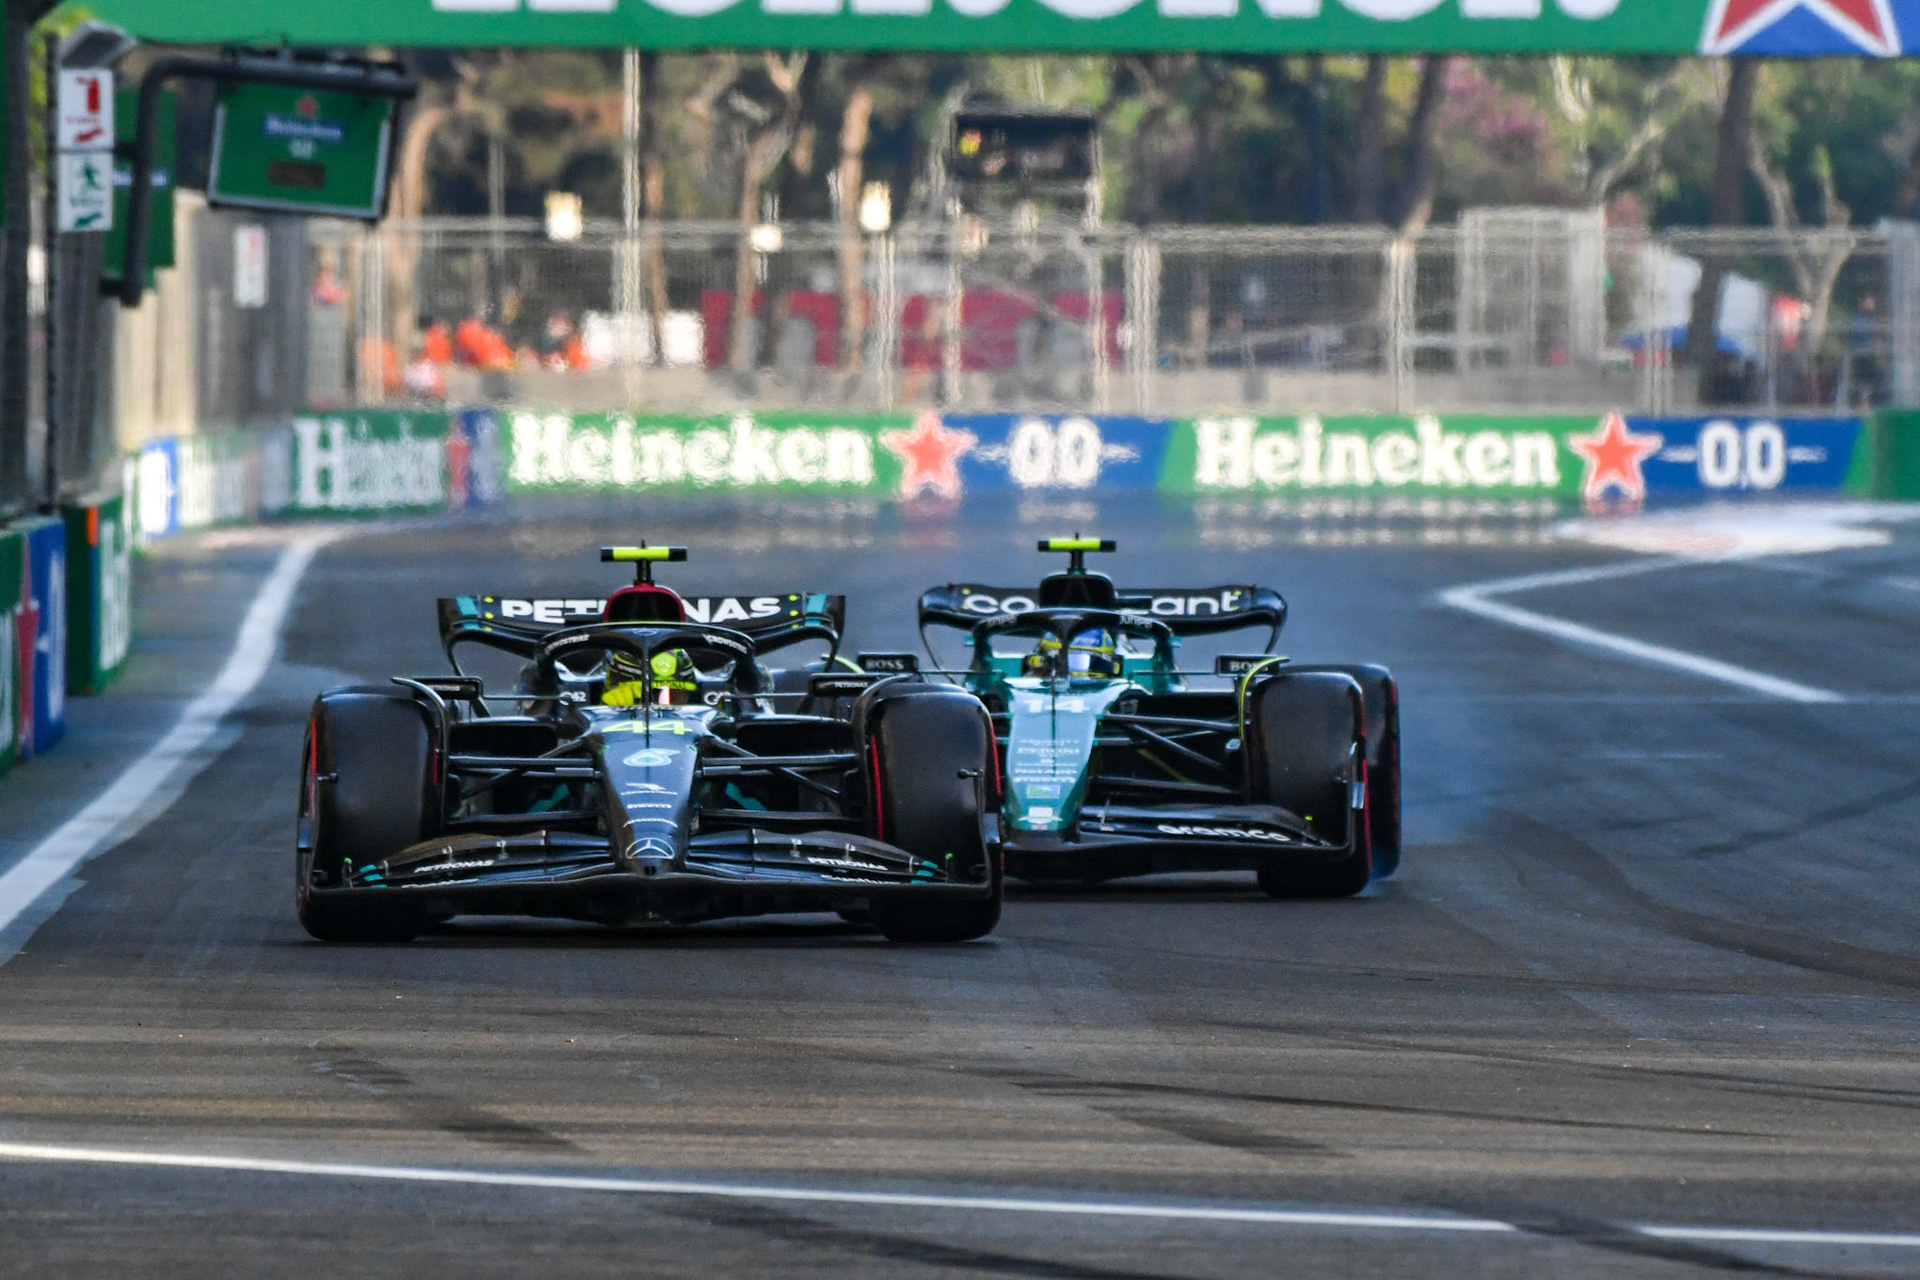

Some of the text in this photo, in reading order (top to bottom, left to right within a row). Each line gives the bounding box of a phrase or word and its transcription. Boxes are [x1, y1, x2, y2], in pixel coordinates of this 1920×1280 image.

[508, 411, 873, 486] Heineken
[1193, 414, 1559, 488] Heineken
[865, 659, 904, 669] BOSS
[1021, 699, 1092, 713] 14
[601, 720, 693, 735] 44
[1157, 824, 1291, 842] aramco
[413, 859, 495, 874] PETRONAS
[807, 856, 889, 871] PETRONAS
